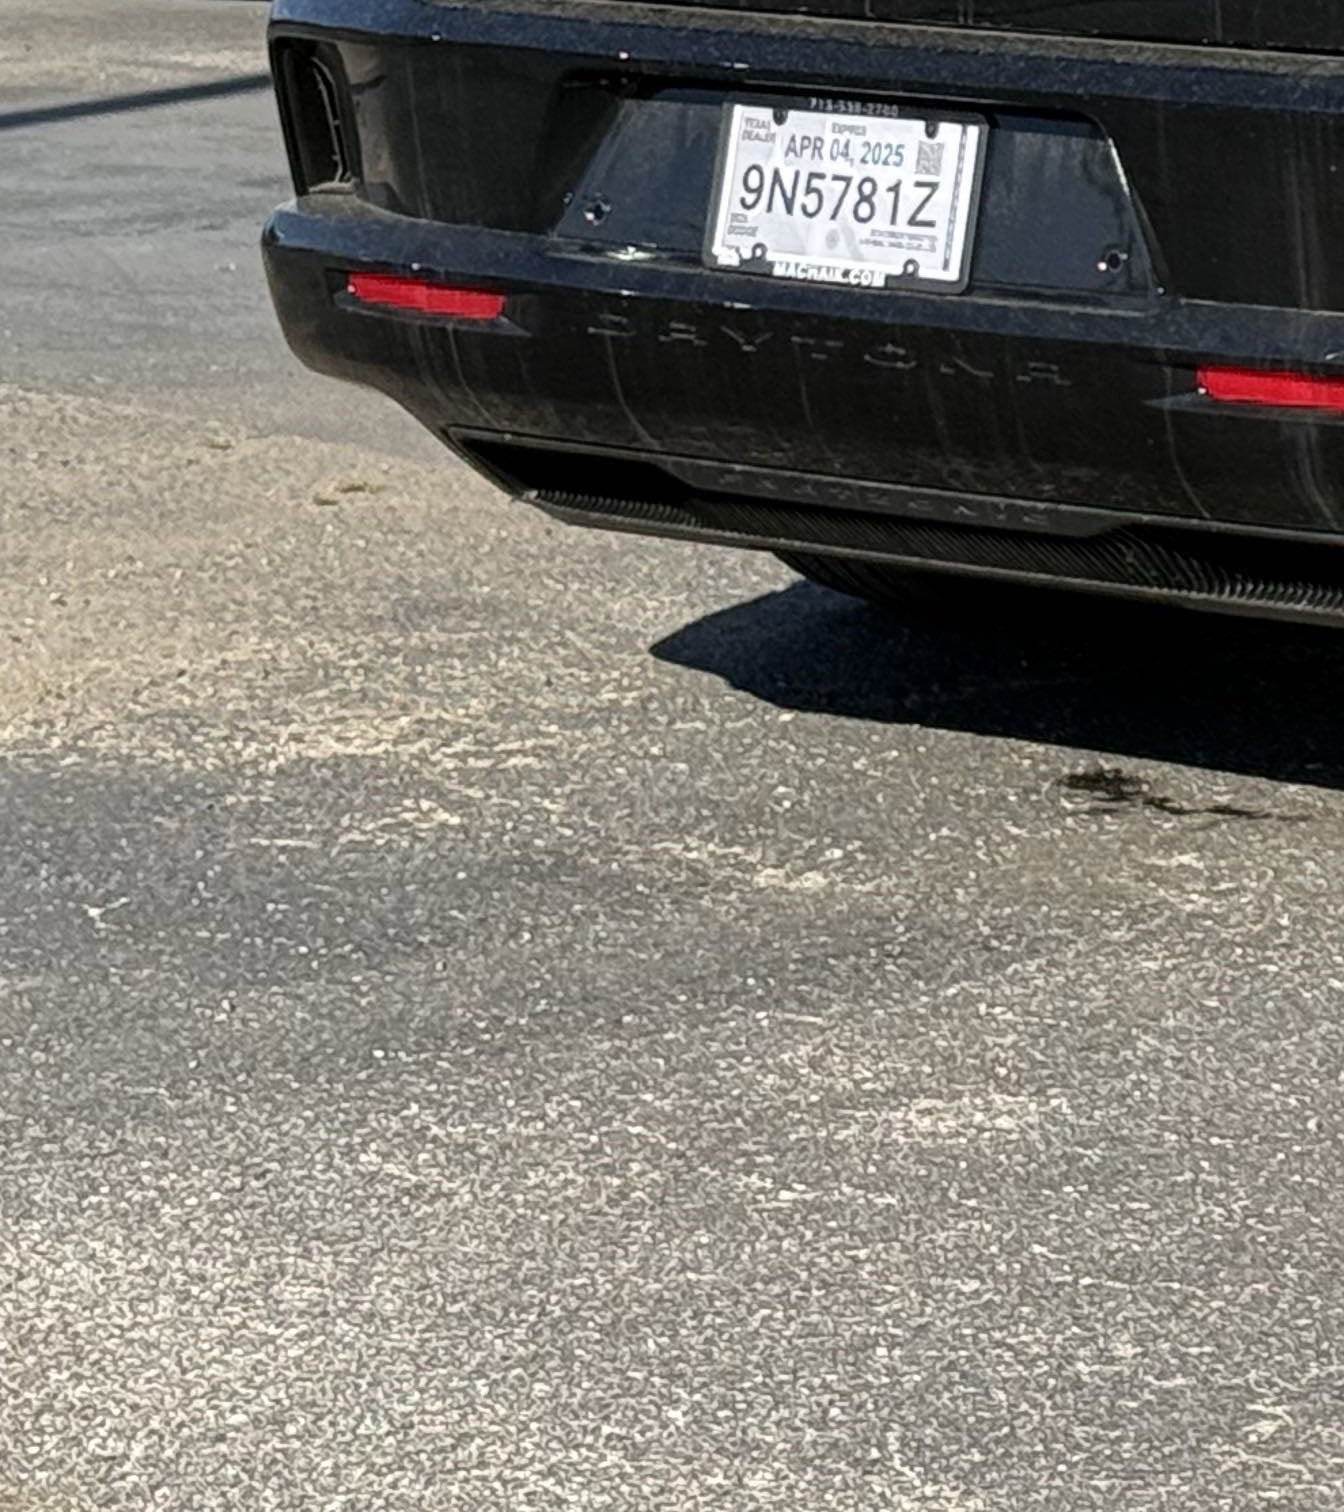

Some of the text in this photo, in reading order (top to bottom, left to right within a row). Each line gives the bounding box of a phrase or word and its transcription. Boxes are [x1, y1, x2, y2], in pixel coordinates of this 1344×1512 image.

[784, 134, 905, 167] APR 04, 2025
[739, 164, 940, 228] 9N5781Z
